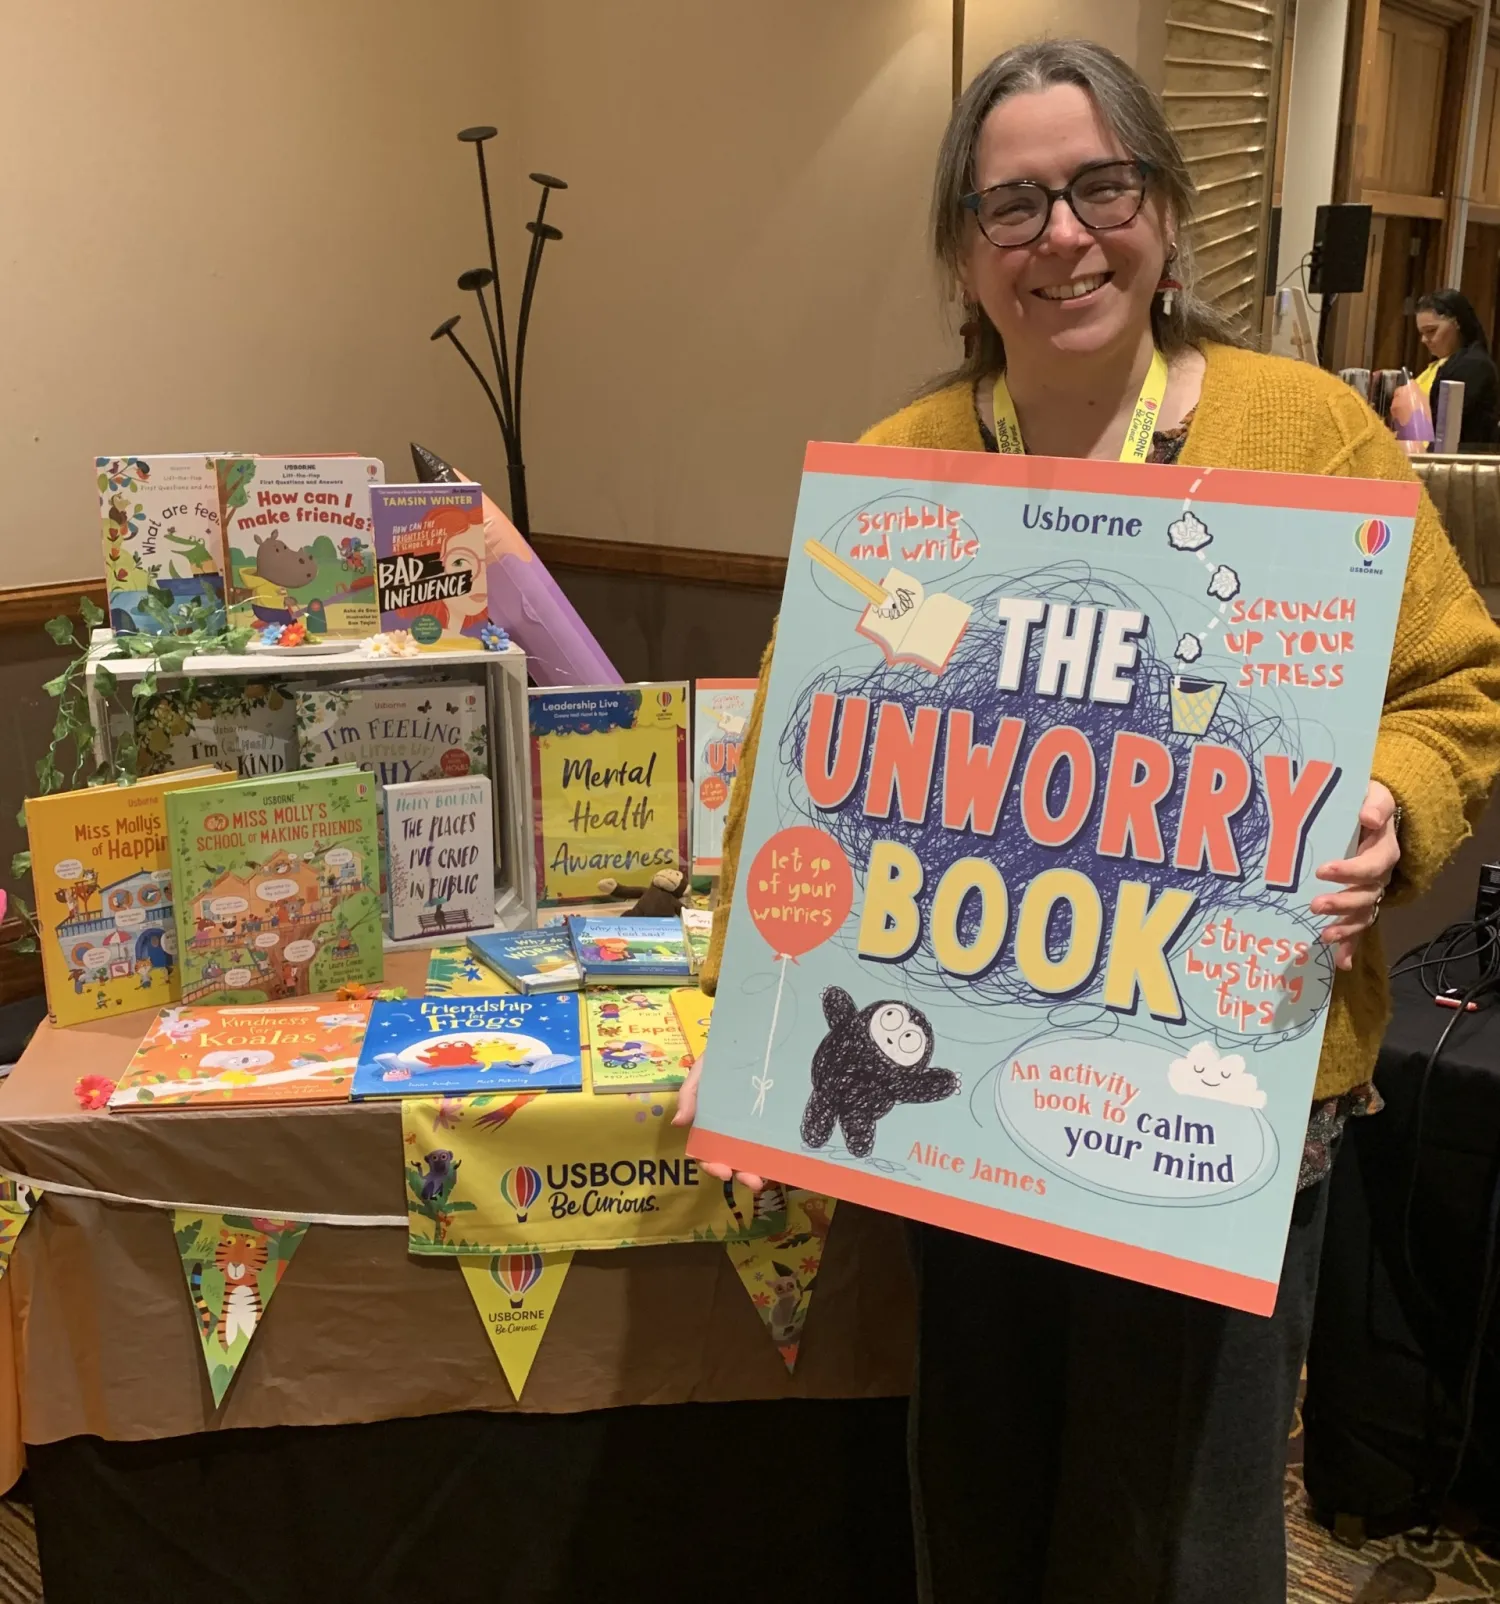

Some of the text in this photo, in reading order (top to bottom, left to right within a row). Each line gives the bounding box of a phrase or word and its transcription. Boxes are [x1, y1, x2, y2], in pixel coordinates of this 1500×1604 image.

[1133, 412, 1155, 458] USBORNE
[257, 490, 353, 508] How can I
[383, 496, 473, 506] TAMSIN WINTER
[142, 518, 162, 556] What
[162, 504, 188, 519] are
[237, 508, 290, 531] make
[392, 525, 407, 535] HOW
[408, 522, 422, 532] CAN
[856, 503, 964, 536] scribble
[1022, 503, 1143, 538] Usborne
[392, 531, 428, 544] BRIGHTEST
[401, 541, 424, 551] SCHOOL
[849, 528, 981, 562] and write
[378, 556, 424, 589] BAD
[1349, 566, 1384, 576] USBORNE
[384, 574, 467, 611] INFLUENCE
[1227, 597, 1356, 625] SCRUNCH
[996, 596, 1151, 708] THE
[1223, 628, 1355, 658] UP YOUR
[1236, 662, 1344, 690] STRESS
[542, 699, 619, 712] Leadership Live
[190, 742, 218, 761] I'm
[323, 726, 361, 751] I'm
[562, 751, 657, 790] Mental
[128, 796, 159, 808] Usborne
[263, 794, 296, 806] USBORNE
[802, 690, 1343, 895] UNWORRY
[75, 814, 161, 842] Miss Molly's
[232, 802, 328, 829] MISS MOLLY'S
[401, 811, 476, 842] THE PLACES
[568, 796, 655, 833] Health
[196, 832, 245, 852] SCHOOL
[260, 824, 309, 845] MAKING
[312, 818, 363, 838] FRIENDS
[92, 843, 103, 856] of
[409, 845, 479, 870] I'VE CRIED
[550, 842, 674, 876] Awareness
[771, 847, 831, 879] let go
[409, 873, 479, 902] IN PUBLIC
[758, 872, 837, 902] of your
[753, 904, 833, 927] worries
[514, 936, 546, 946] Why
[858, 838, 1196, 1026] BOOK
[1199, 916, 1309, 967] stress
[1185, 947, 1304, 1005] busting
[420, 998, 533, 1016] Friendship
[468, 1012, 485, 1020] for
[1213, 980, 1274, 1033] tips
[221, 1015, 310, 1029] Kindness
[249, 1026, 271, 1034] for
[425, 1013, 524, 1033] Frogs
[199, 1029, 317, 1048] Koalas
[1010, 1060, 1141, 1106] An activity
[1033, 1088, 1216, 1146] book to calm
[1063, 1124, 1236, 1185] your mind
[546, 1159, 699, 1190] USBORNE
[906, 1141, 1048, 1197] Alice James
[550, 1190, 660, 1220] Be Curious.
[488, 1308, 545, 1324] USBORNE
[495, 1323, 508, 1335] Be
